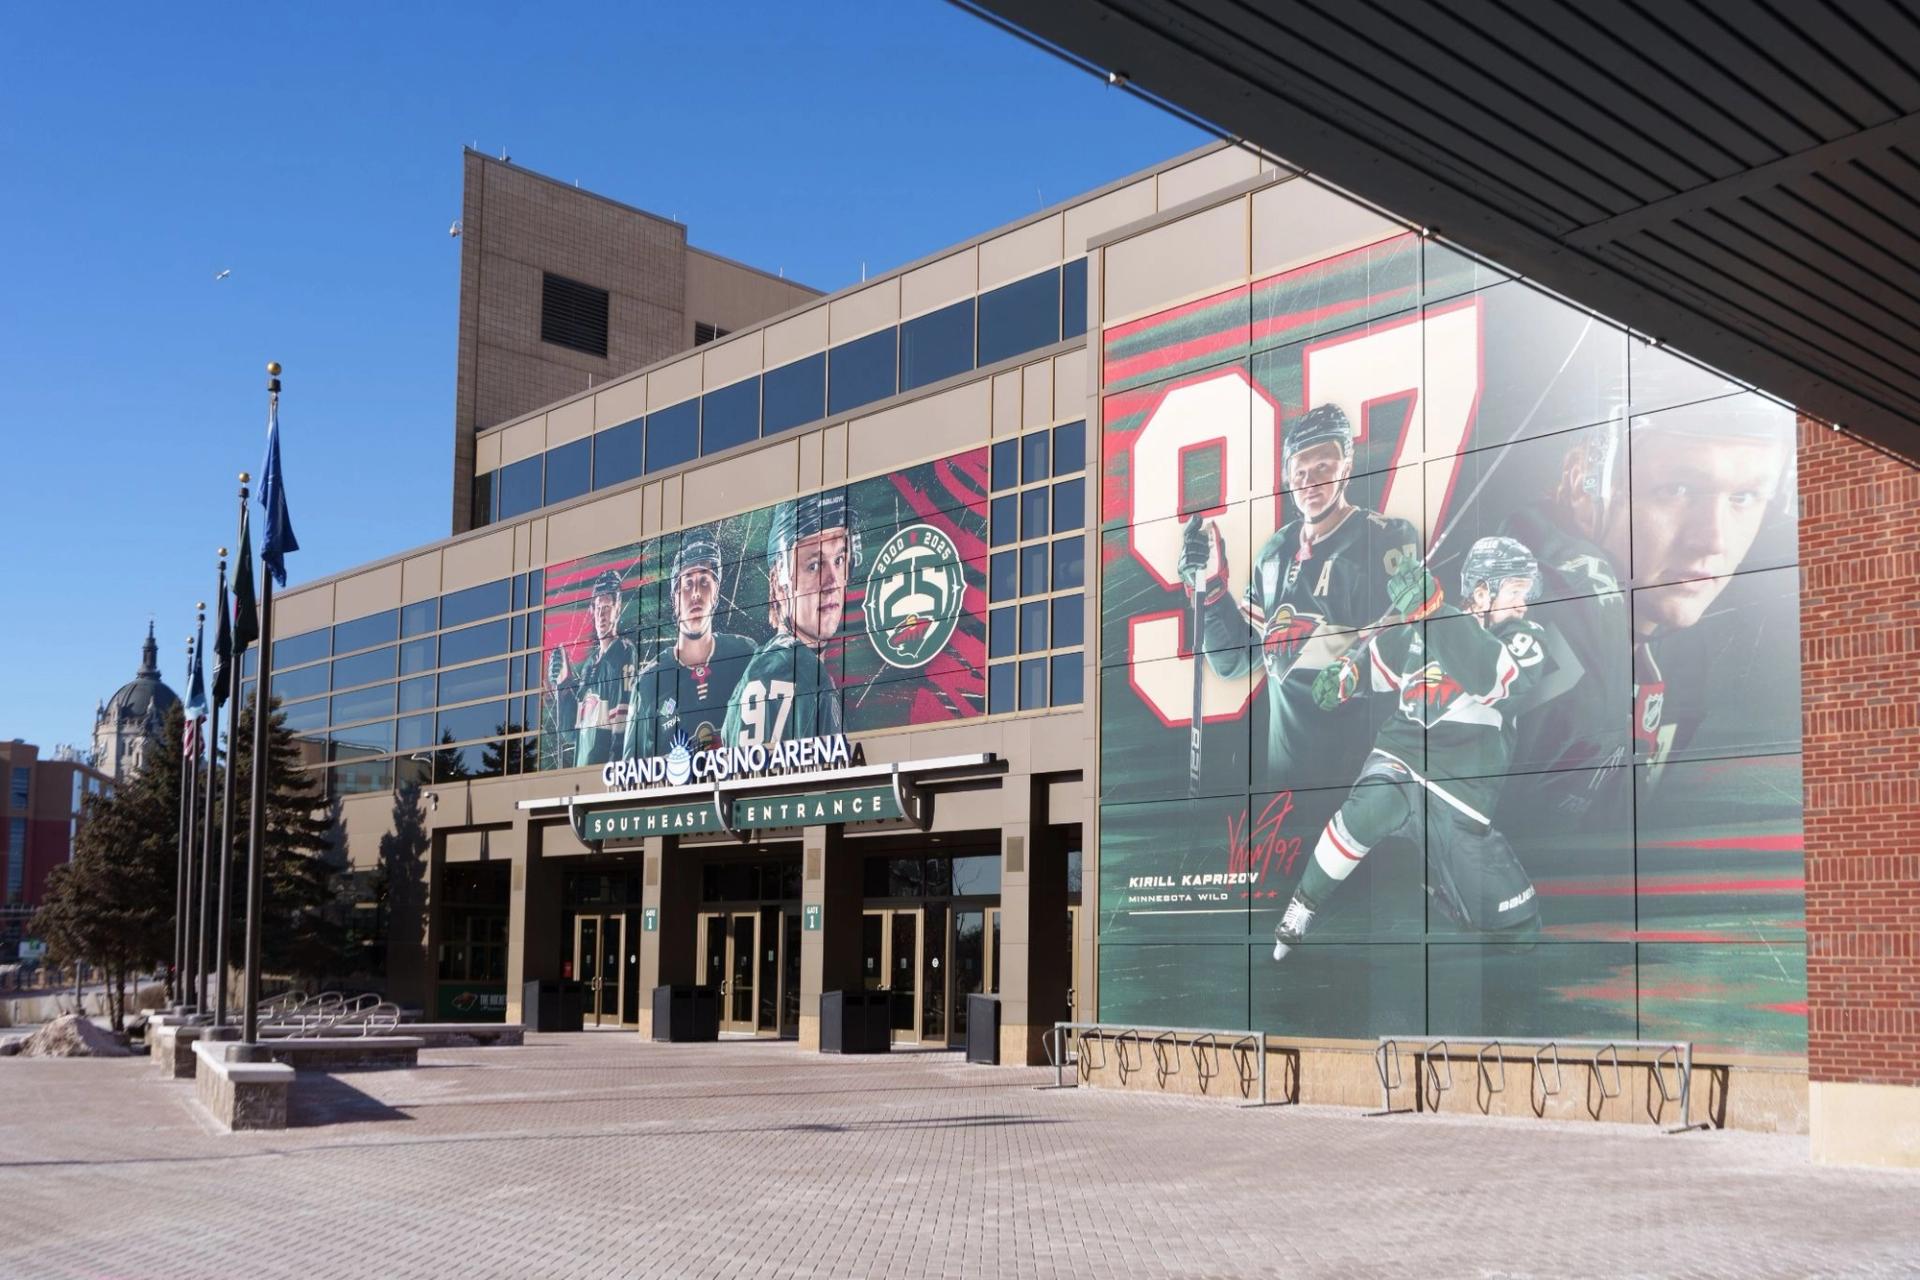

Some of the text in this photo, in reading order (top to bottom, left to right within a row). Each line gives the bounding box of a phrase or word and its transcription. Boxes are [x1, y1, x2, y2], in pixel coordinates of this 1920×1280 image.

[1131, 299, 1482, 728] 97
[877, 538, 905, 574] 2000
[923, 532, 951, 560] 2025
[1507, 632, 1545, 668] 97
[738, 680, 794, 745] 97
[602, 734, 849, 786] GRAND CASINO ARENA
[594, 796, 881, 833] SOUTHEAST ENTRANCE
[1128, 893, 1228, 903] MINNESOTA WILD
[1129, 872, 1259, 888] KIRILL KAPRIZOV
[806, 906, 819, 914] GATE
[809, 915, 815, 928] 1
